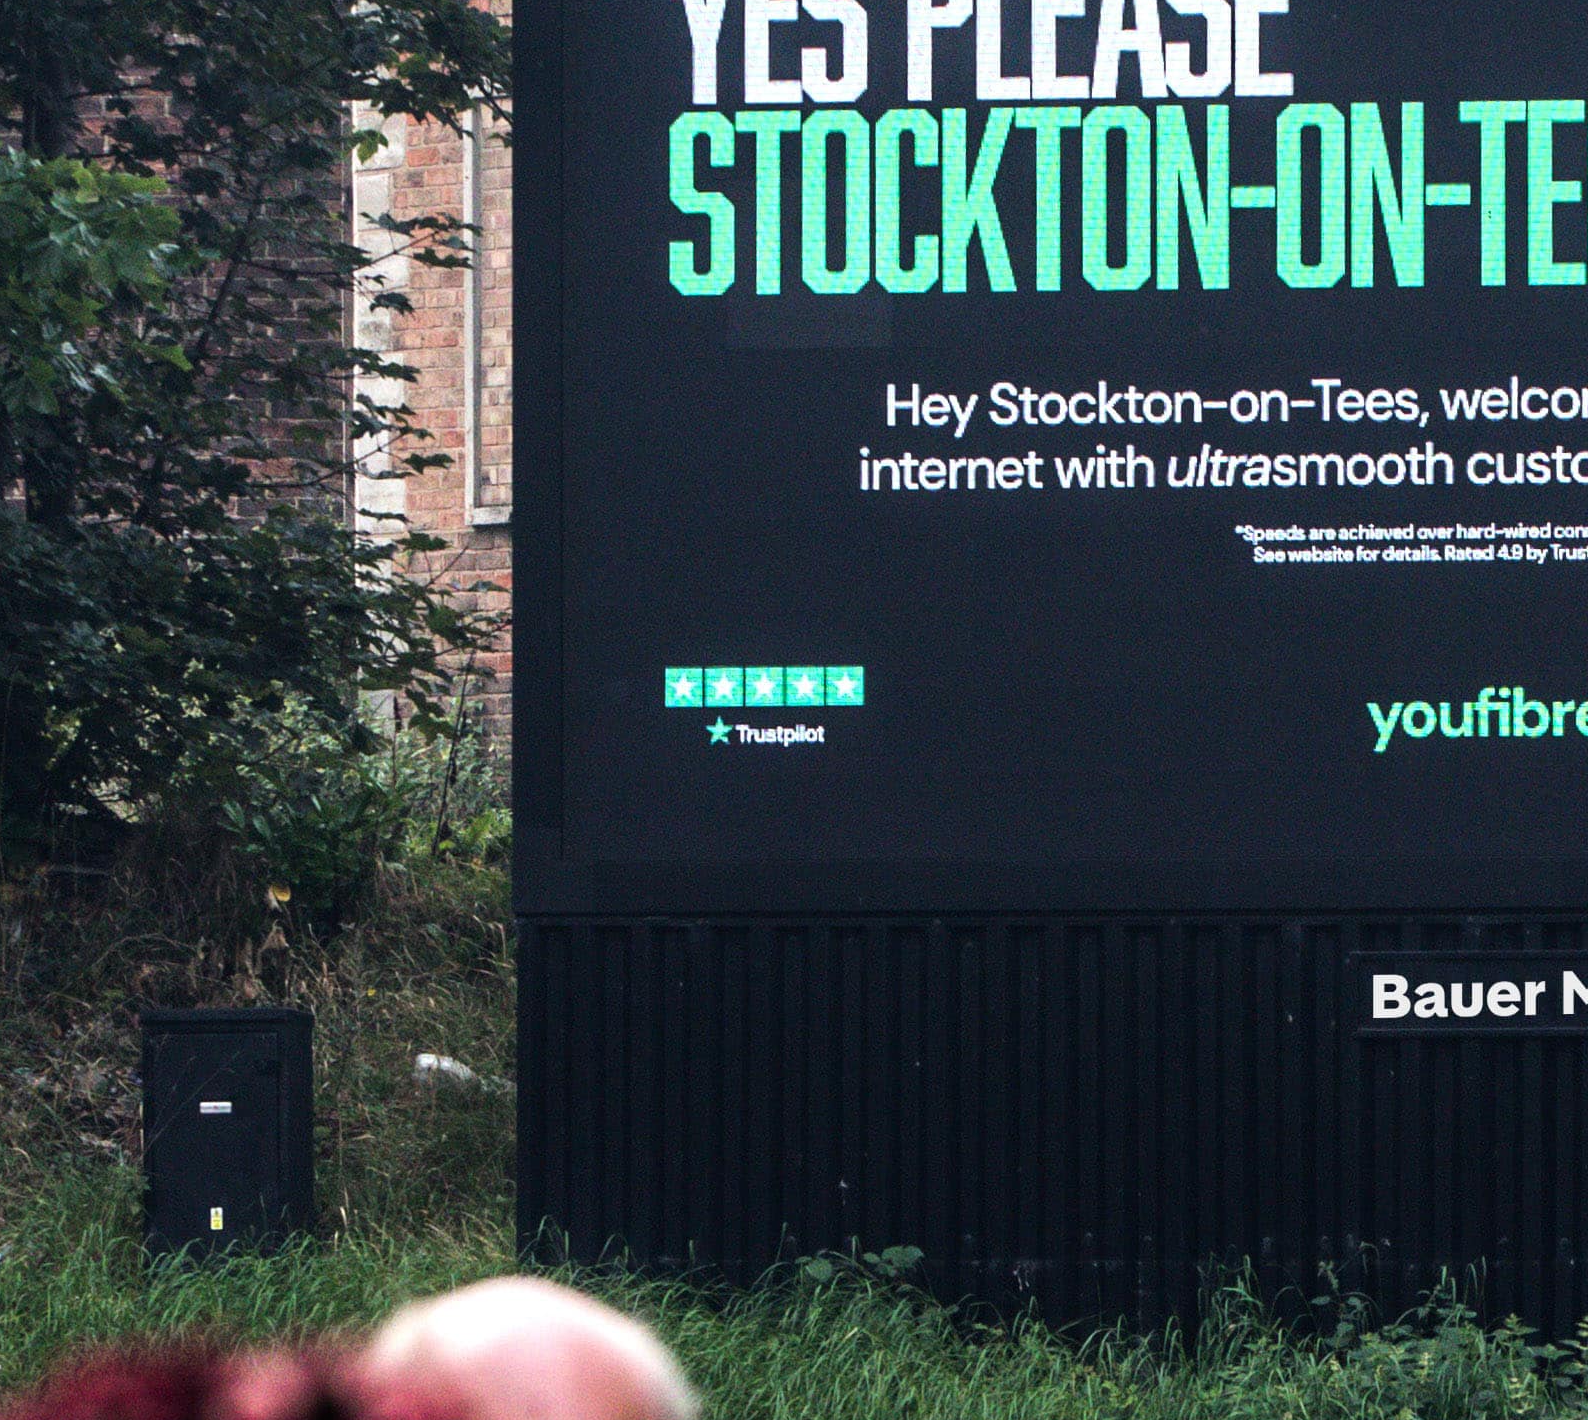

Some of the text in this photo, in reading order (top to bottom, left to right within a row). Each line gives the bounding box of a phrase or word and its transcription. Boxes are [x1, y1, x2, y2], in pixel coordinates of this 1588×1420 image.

[888, 385, 979, 435] Hey
[990, 378, 1430, 429] Stockton-on-Tees,
[861, 447, 1044, 492] internet
[1055, 444, 1156, 490] with
[1168, 442, 1455, 489] ultrasmooth
[1309, 528, 1337, 540] are
[1338, 524, 1414, 540] achieved
[1417, 527, 1454, 539] over
[1456, 523, 1552, 539] hard-wired
[1253, 546, 1286, 564] See
[1288, 546, 1355, 563] website
[1356, 546, 1381, 562] for
[1382, 545, 1443, 562] details.
[1444, 545, 1495, 561] Rated
[1497, 544, 1524, 561] 4.9
[1526, 544, 1549, 565] by
[735, 724, 826, 748] Trustpilot
[1372, 974, 1546, 1019] Bauer
